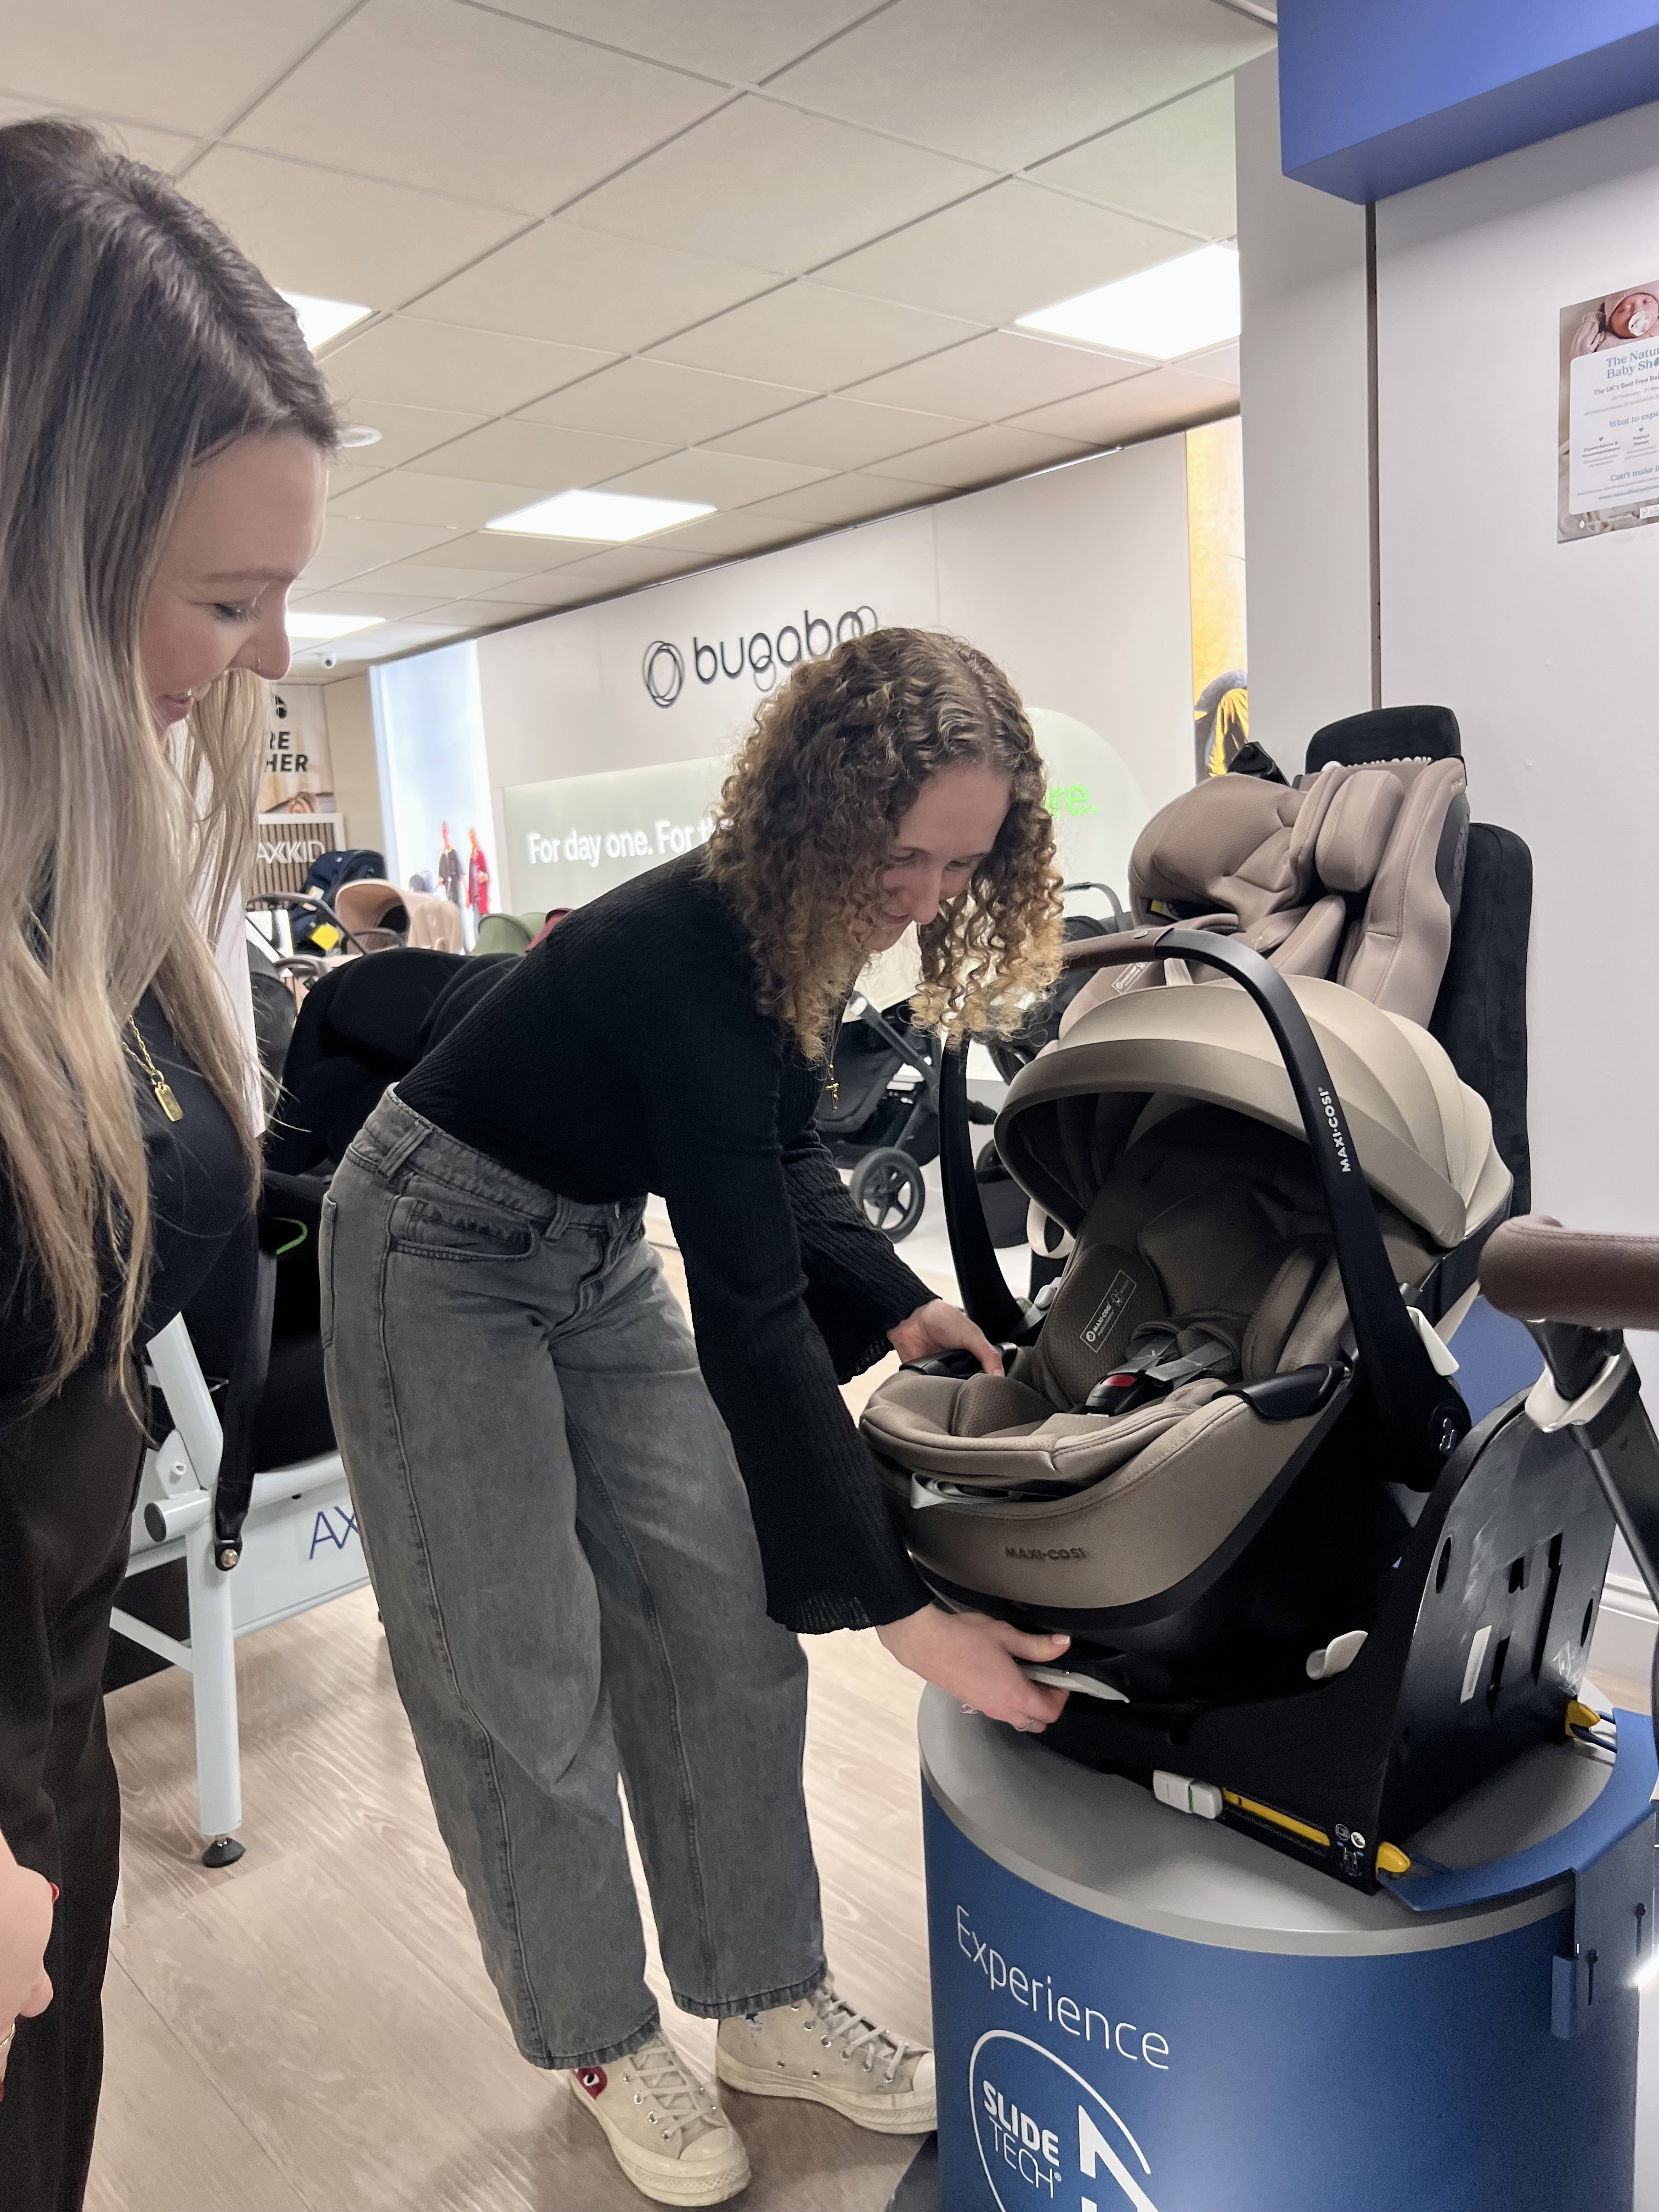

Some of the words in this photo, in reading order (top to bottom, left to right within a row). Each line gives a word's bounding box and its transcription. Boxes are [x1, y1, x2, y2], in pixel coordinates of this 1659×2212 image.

[1606, 356, 1627, 367] The
[1607, 364, 1635, 379] Baby
[1610, 418, 1629, 427] What
[1611, 472, 1630, 481] Can't
[1633, 467, 1653, 477] make
[527, 832, 558, 864] For
[564, 827, 602, 867] day
[606, 828, 653, 859] one.
[654, 818, 695, 854] For
[957, 1905, 1169, 2069] Experience
[983, 2080, 1060, 2167] SLIDE
